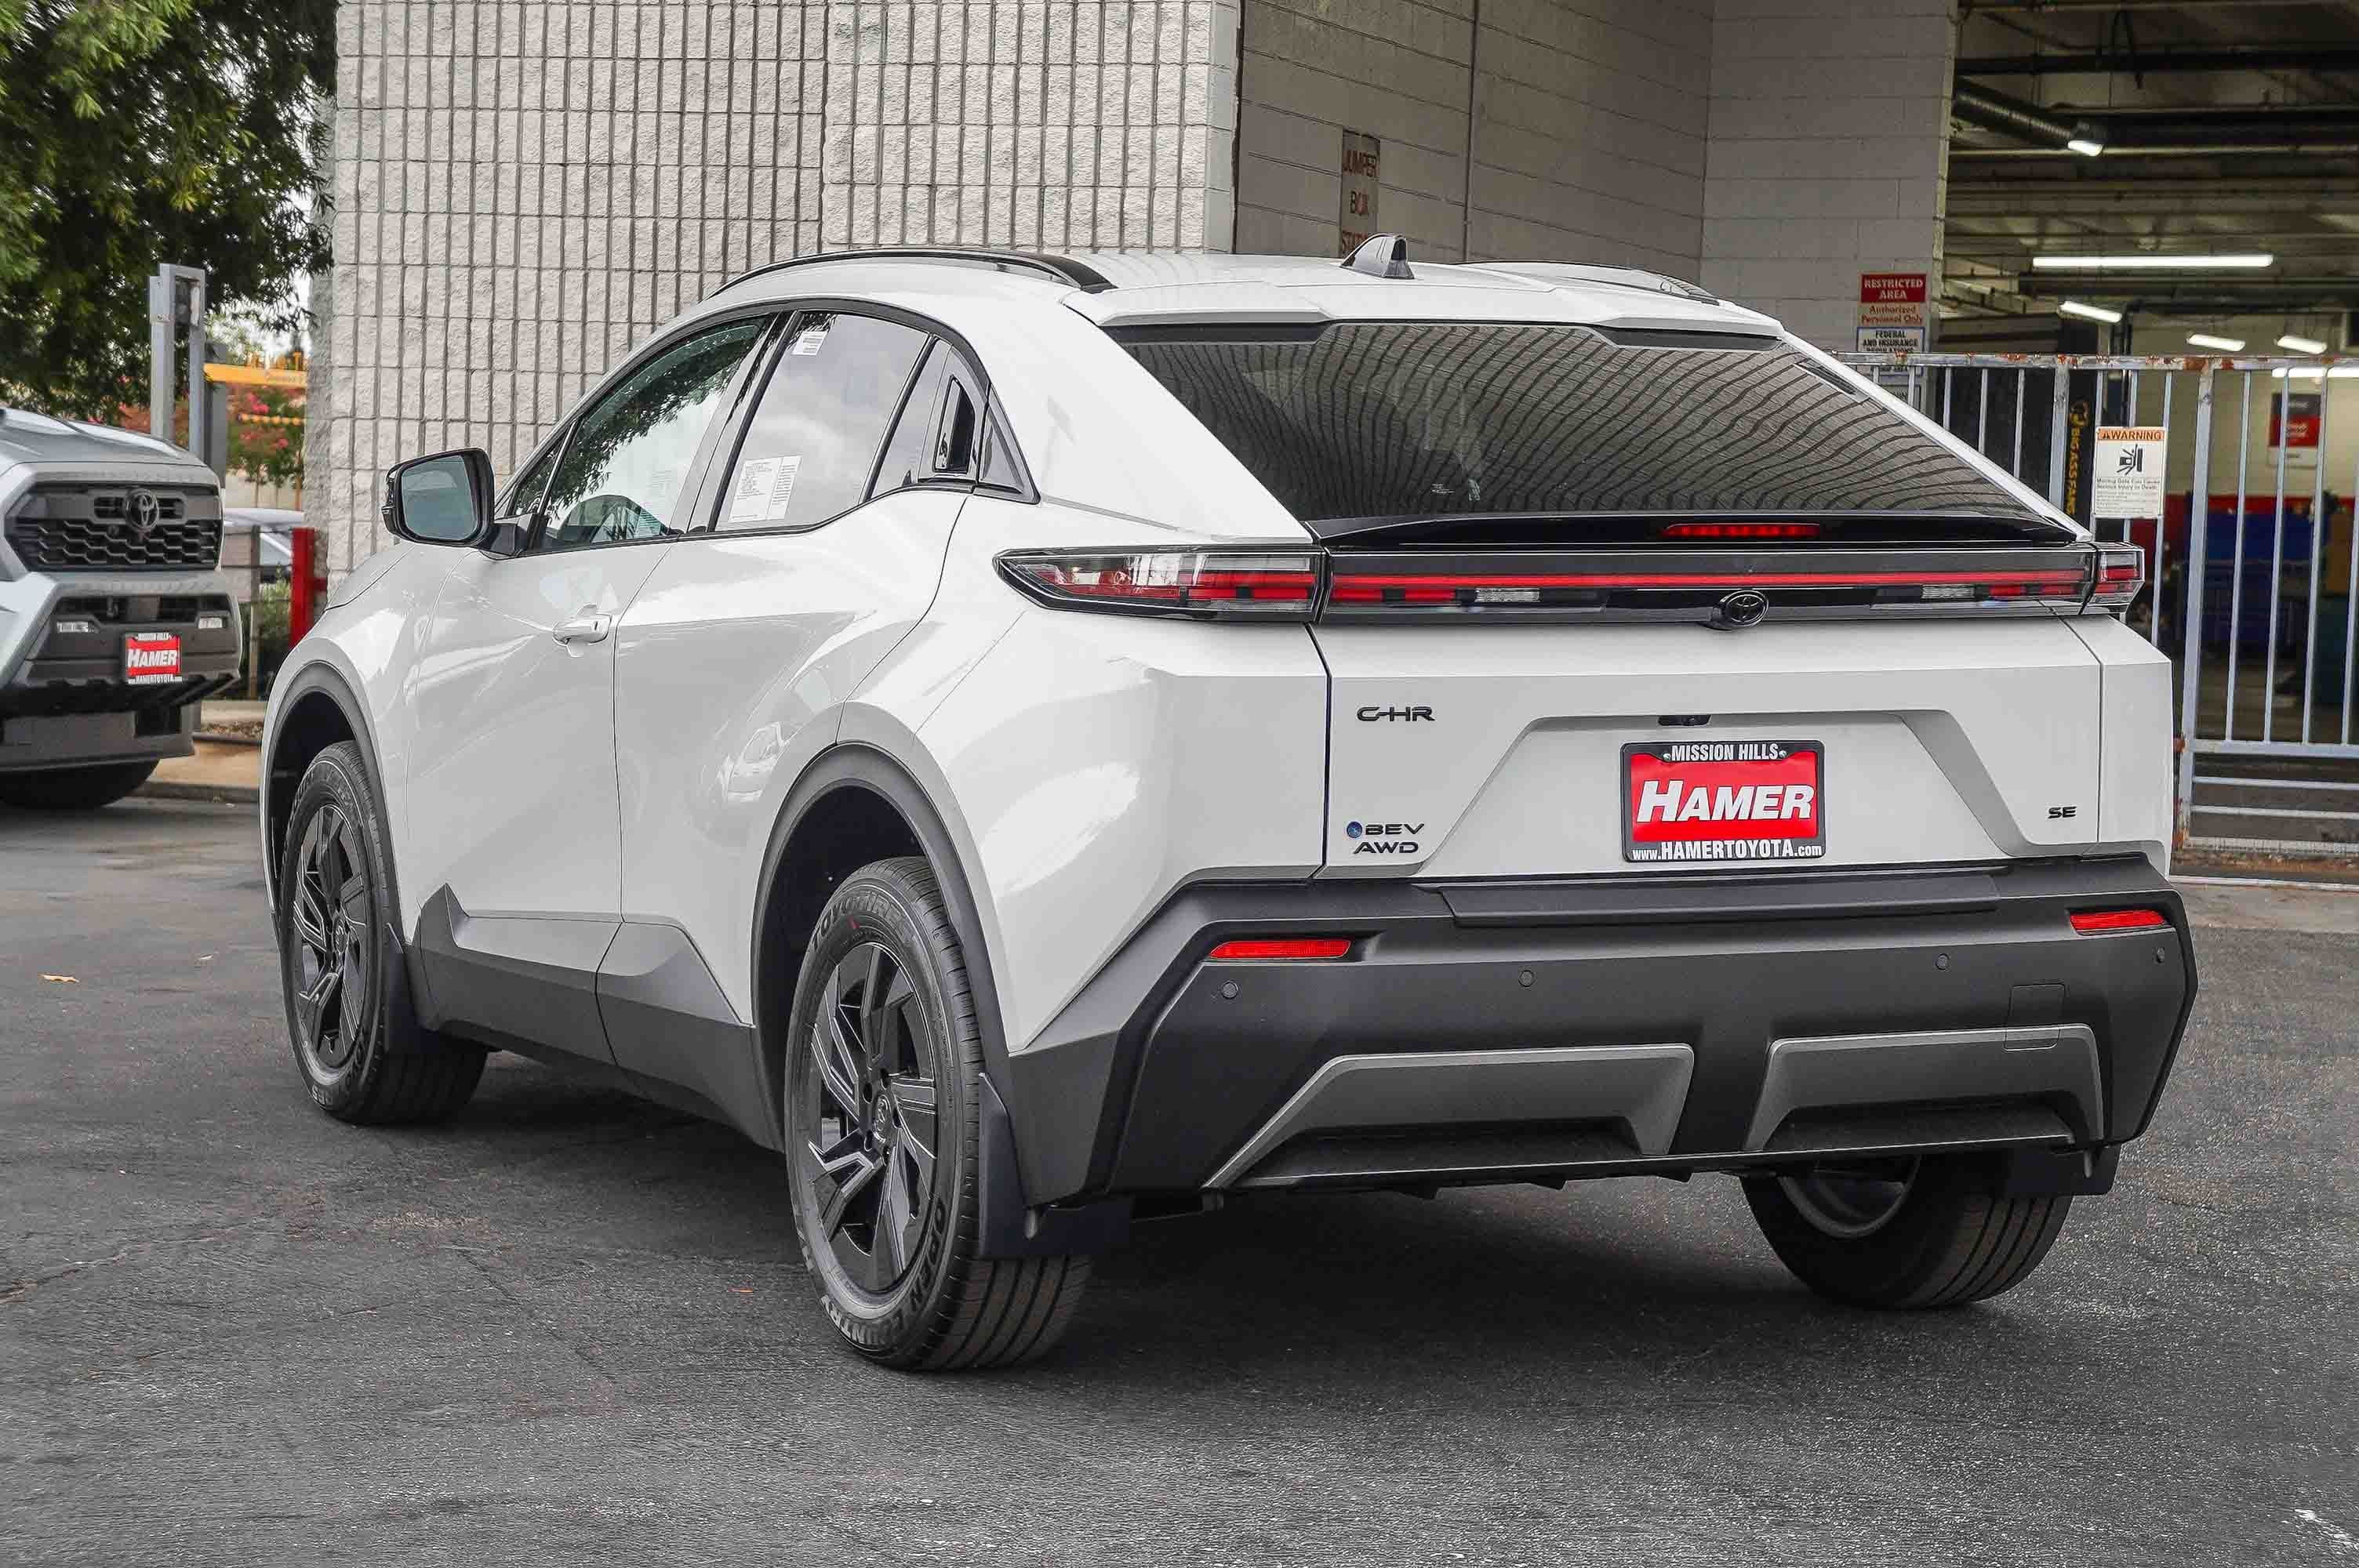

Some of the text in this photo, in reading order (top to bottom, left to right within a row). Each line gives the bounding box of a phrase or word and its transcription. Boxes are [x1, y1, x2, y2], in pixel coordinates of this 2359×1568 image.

[1864, 278, 1923, 289] RESTRICTED
[1879, 289, 1907, 299] AREA
[1870, 305, 1915, 314] Authorized
[2111, 430, 2161, 439] WARNING
[128, 649, 177, 667] HAMER
[1357, 706, 1436, 721] C-HR
[1671, 743, 1779, 761] MISSION HILLS
[1636, 779, 1816, 823] HAMER
[2048, 806, 2077, 818] SE
[1365, 823, 1425, 836] BEV
[1353, 841, 1419, 855] AWD
[1631, 839, 1823, 861] www.HAMERTOYOTA.com
